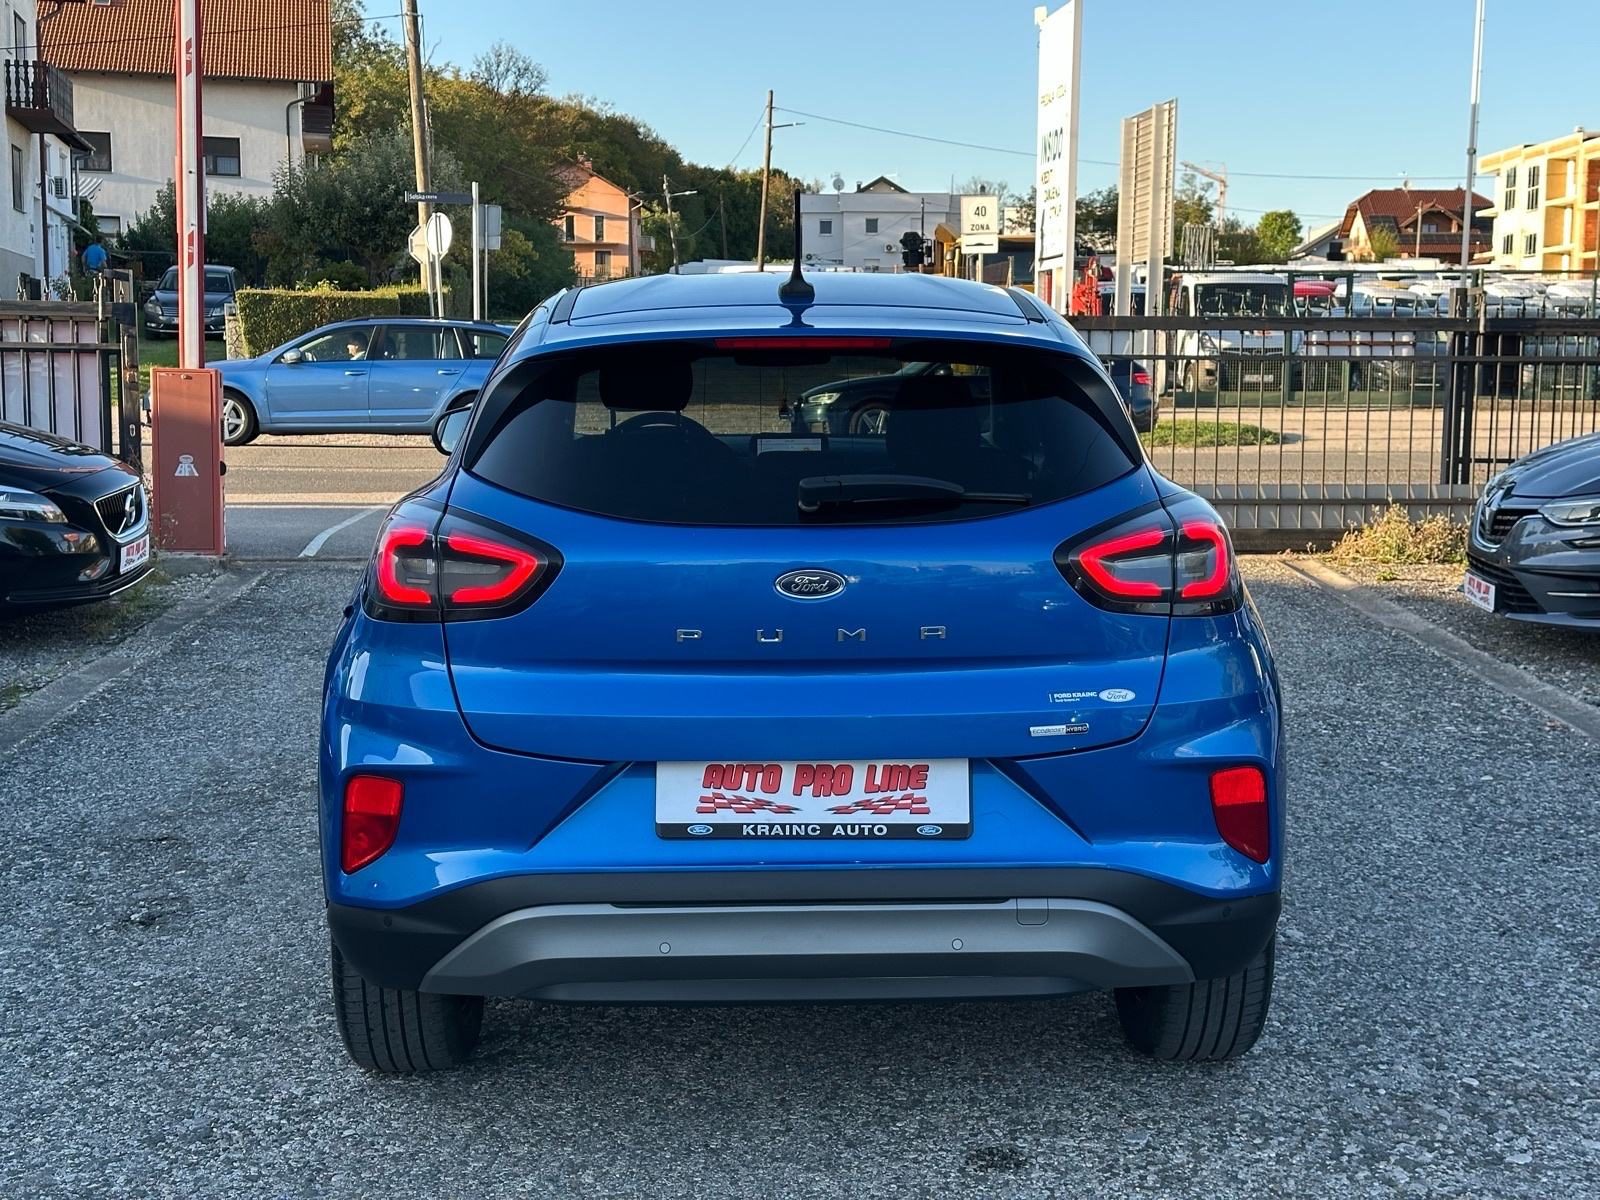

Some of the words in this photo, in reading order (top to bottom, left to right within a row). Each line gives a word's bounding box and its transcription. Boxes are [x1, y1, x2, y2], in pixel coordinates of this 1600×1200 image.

[974, 205, 987, 217] 40
[970, 223, 990, 231] ZONA
[676, 625, 947, 643] PUMA
[1066, 725, 1088, 734] HYBRID
[702, 763, 784, 794] AUTO
[792, 764, 855, 797] PRO
[864, 764, 930, 794] LINE
[742, 824, 821, 836] KRAINC
[832, 824, 888, 836] AUTO
